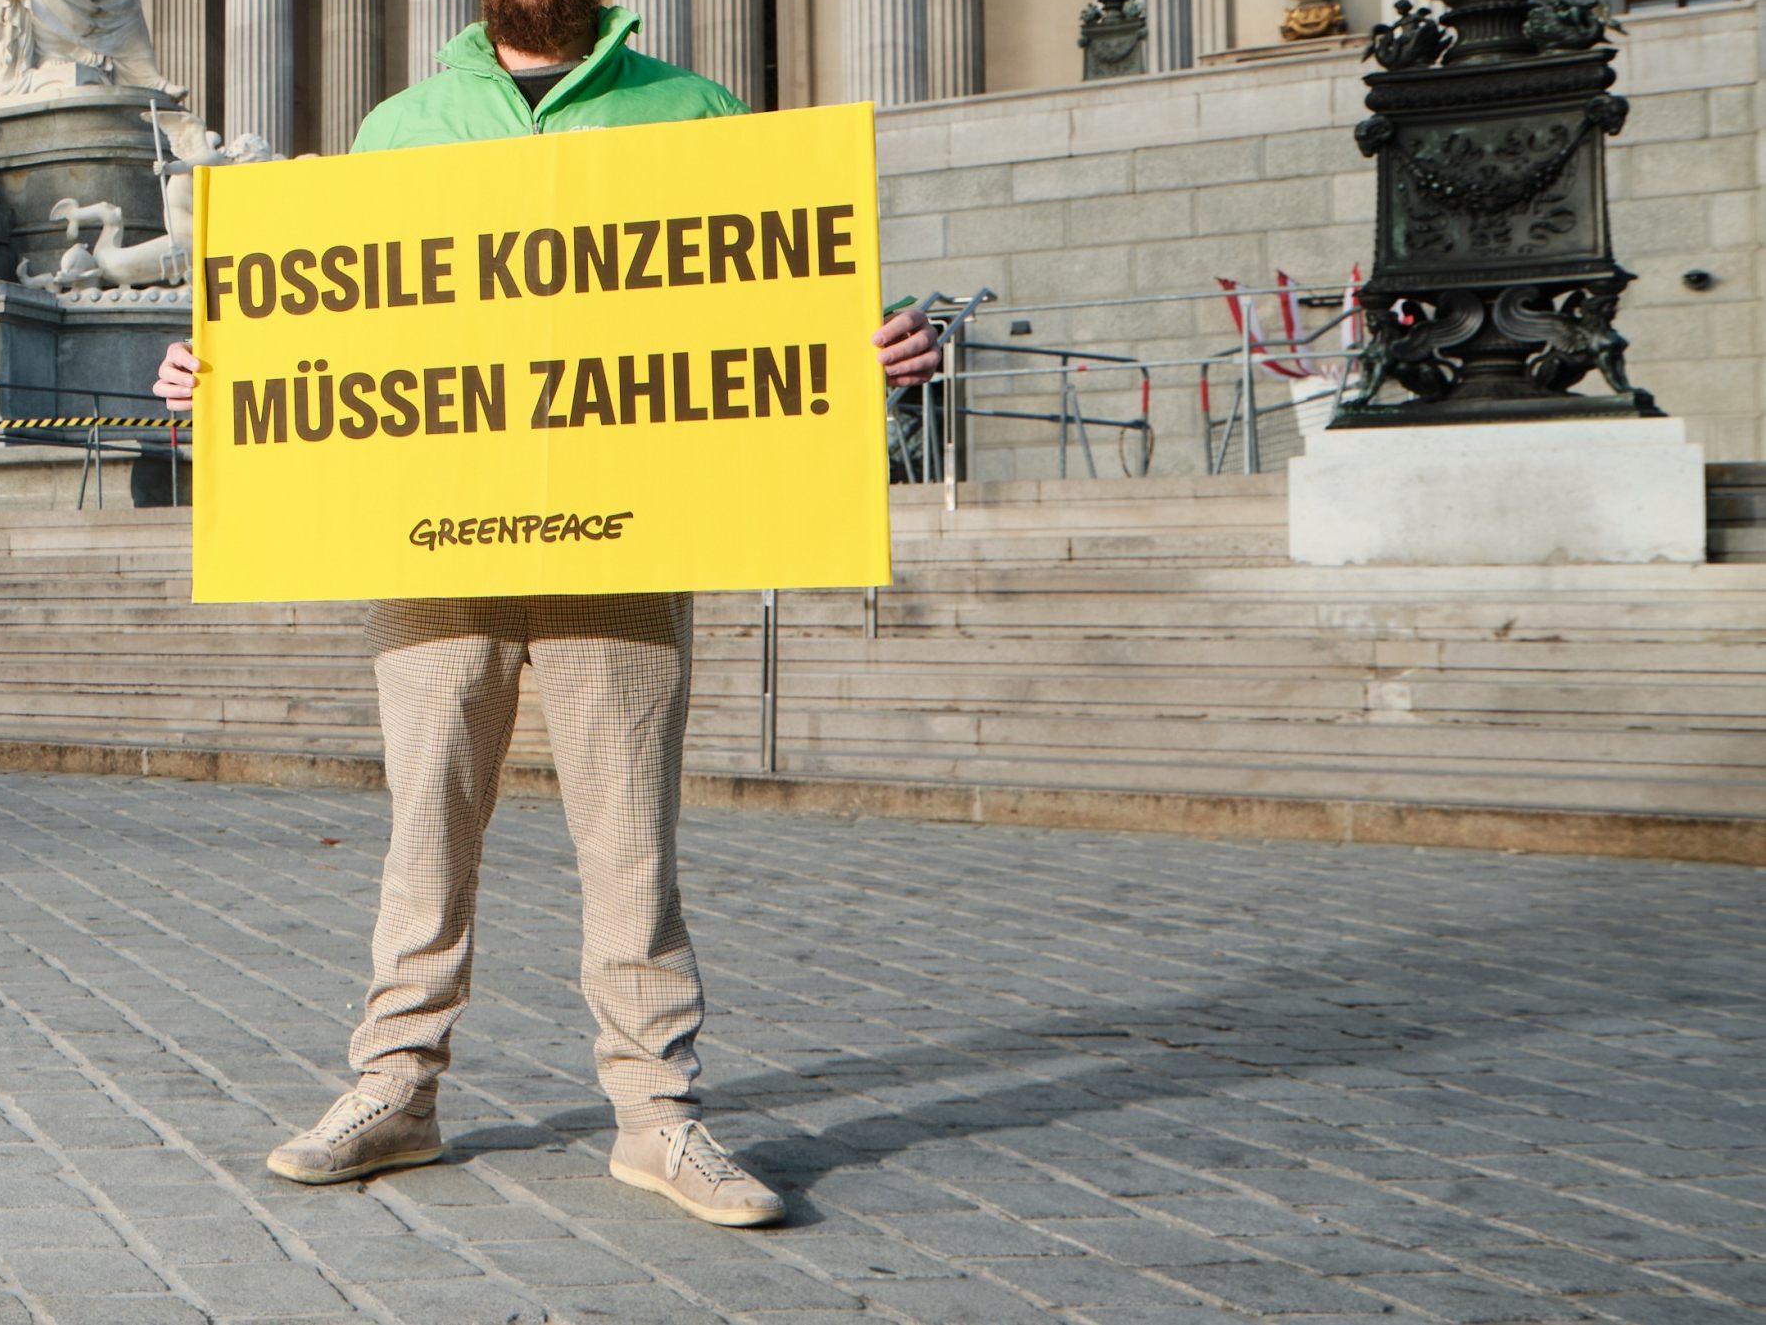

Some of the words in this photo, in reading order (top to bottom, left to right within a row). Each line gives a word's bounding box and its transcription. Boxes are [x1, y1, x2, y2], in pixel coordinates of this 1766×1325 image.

[204, 237, 455, 322] FOSSILE
[479, 204, 856, 301] KONZERNE
[232, 359, 506, 446] MÜSSEN
[529, 343, 830, 430] ZAHLEN!
[409, 511, 634, 552] GREENPEACE
